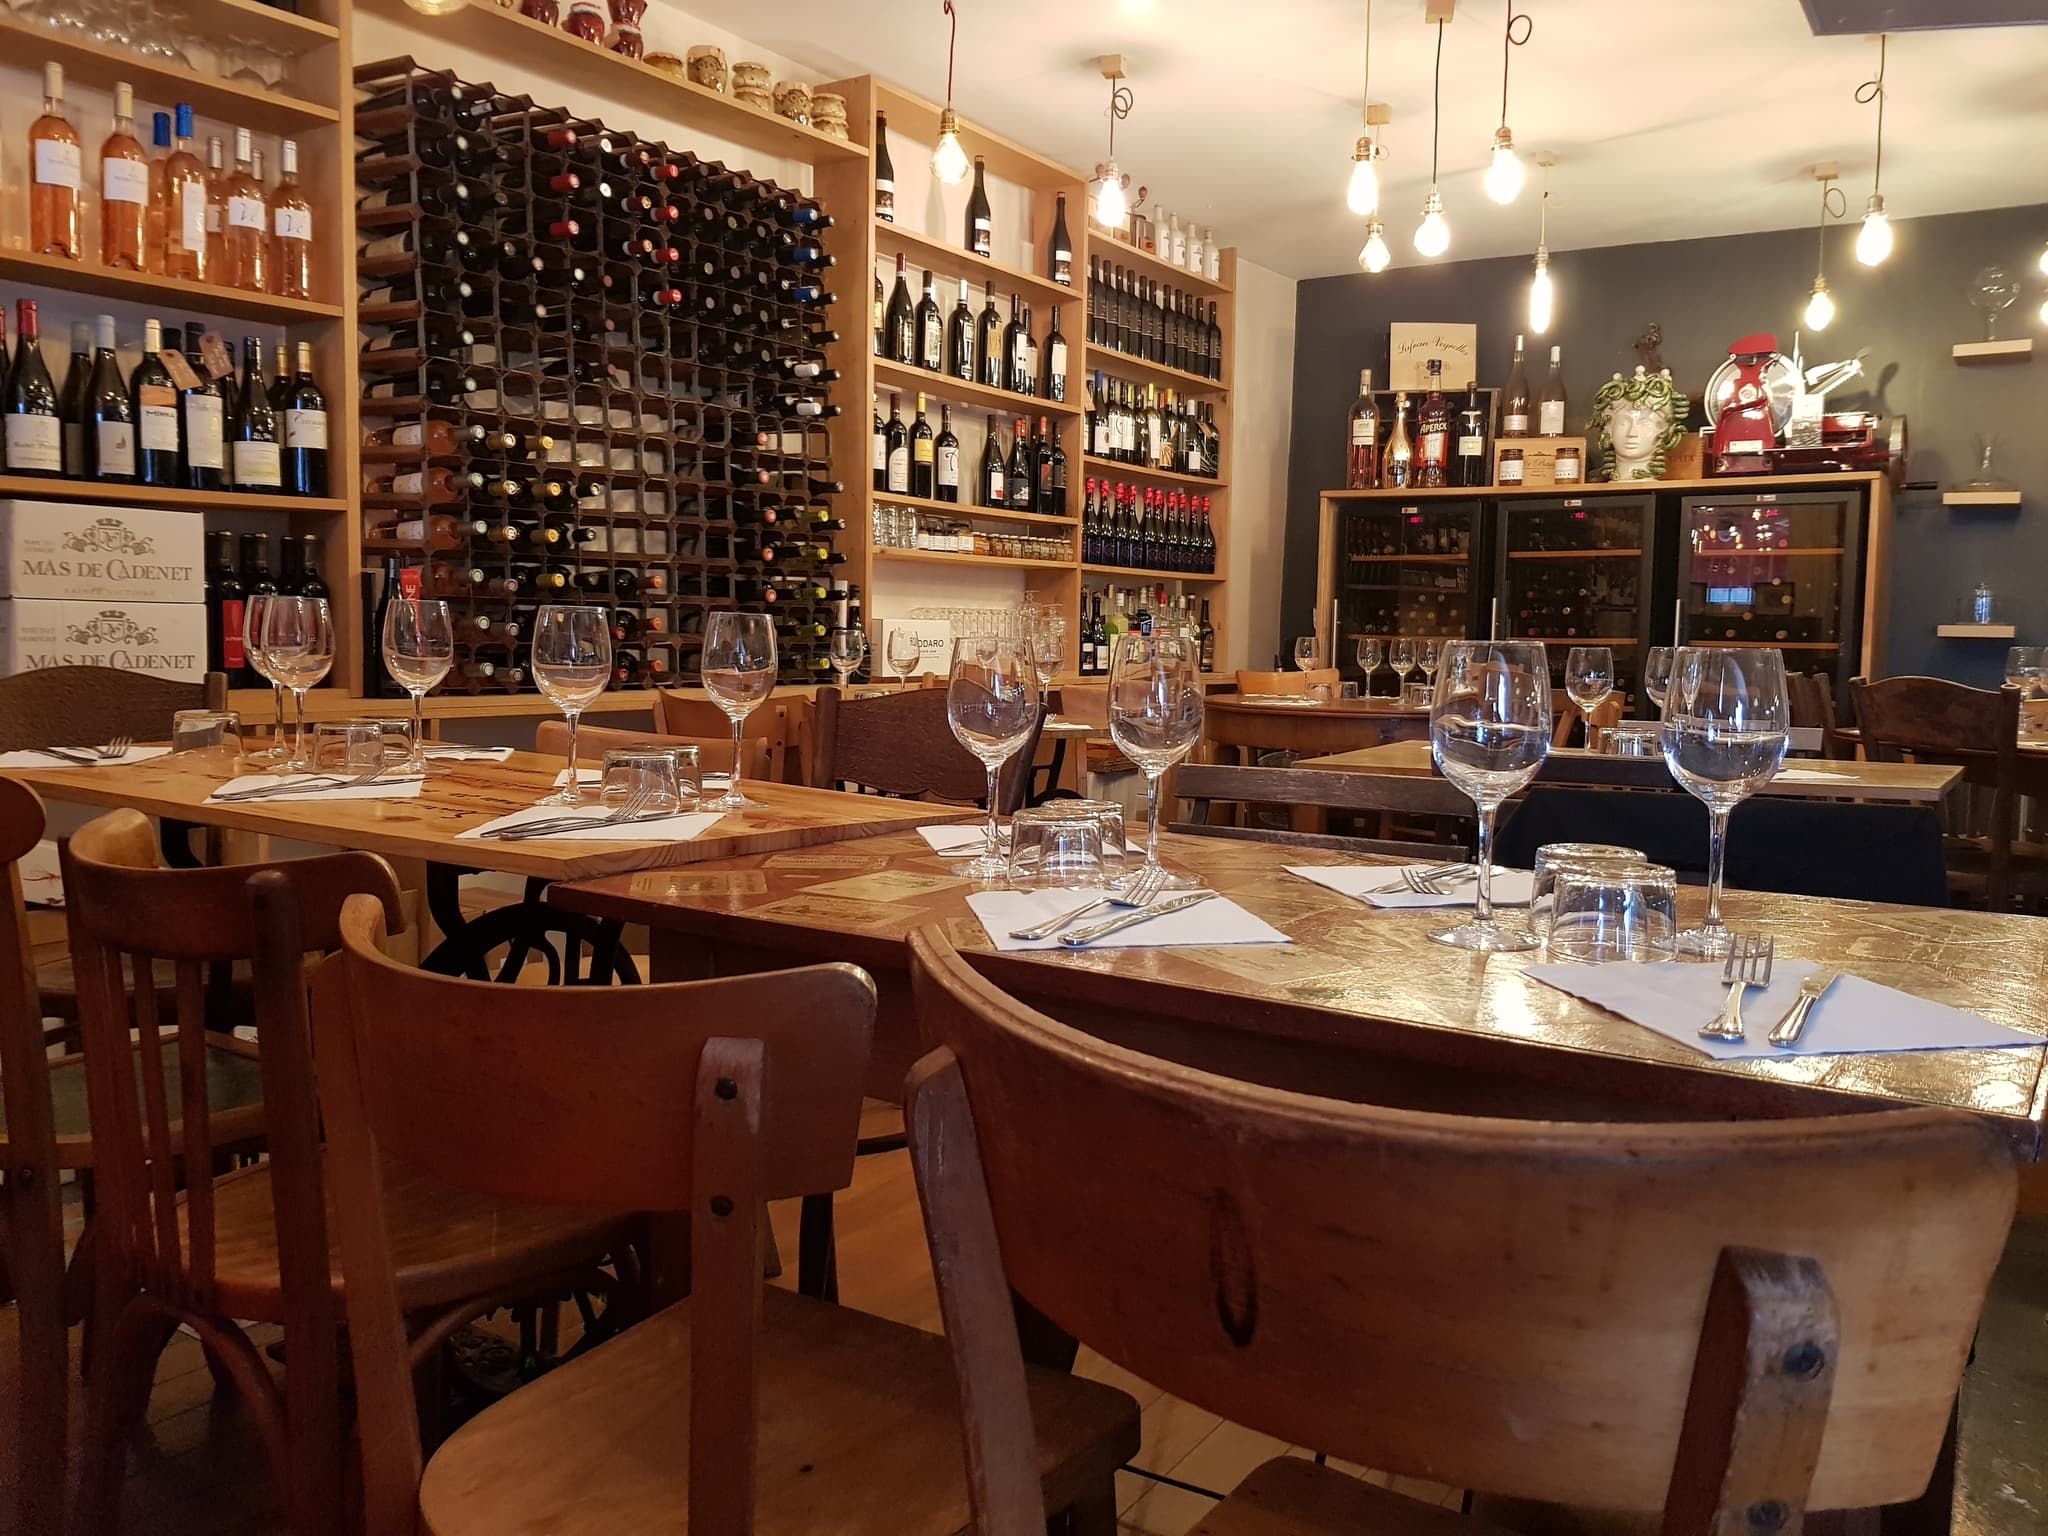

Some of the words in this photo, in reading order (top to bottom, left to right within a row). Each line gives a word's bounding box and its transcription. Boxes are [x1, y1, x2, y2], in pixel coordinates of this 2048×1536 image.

[1420, 422, 1448, 433] APEROL
[22, 559, 71, 576] MAS
[77, 562, 103, 578] DE
[106, 558, 193, 581] CADENET
[25, 654, 73, 669] MAS
[80, 654, 106, 667] DE
[109, 650, 196, 669] CADENET
